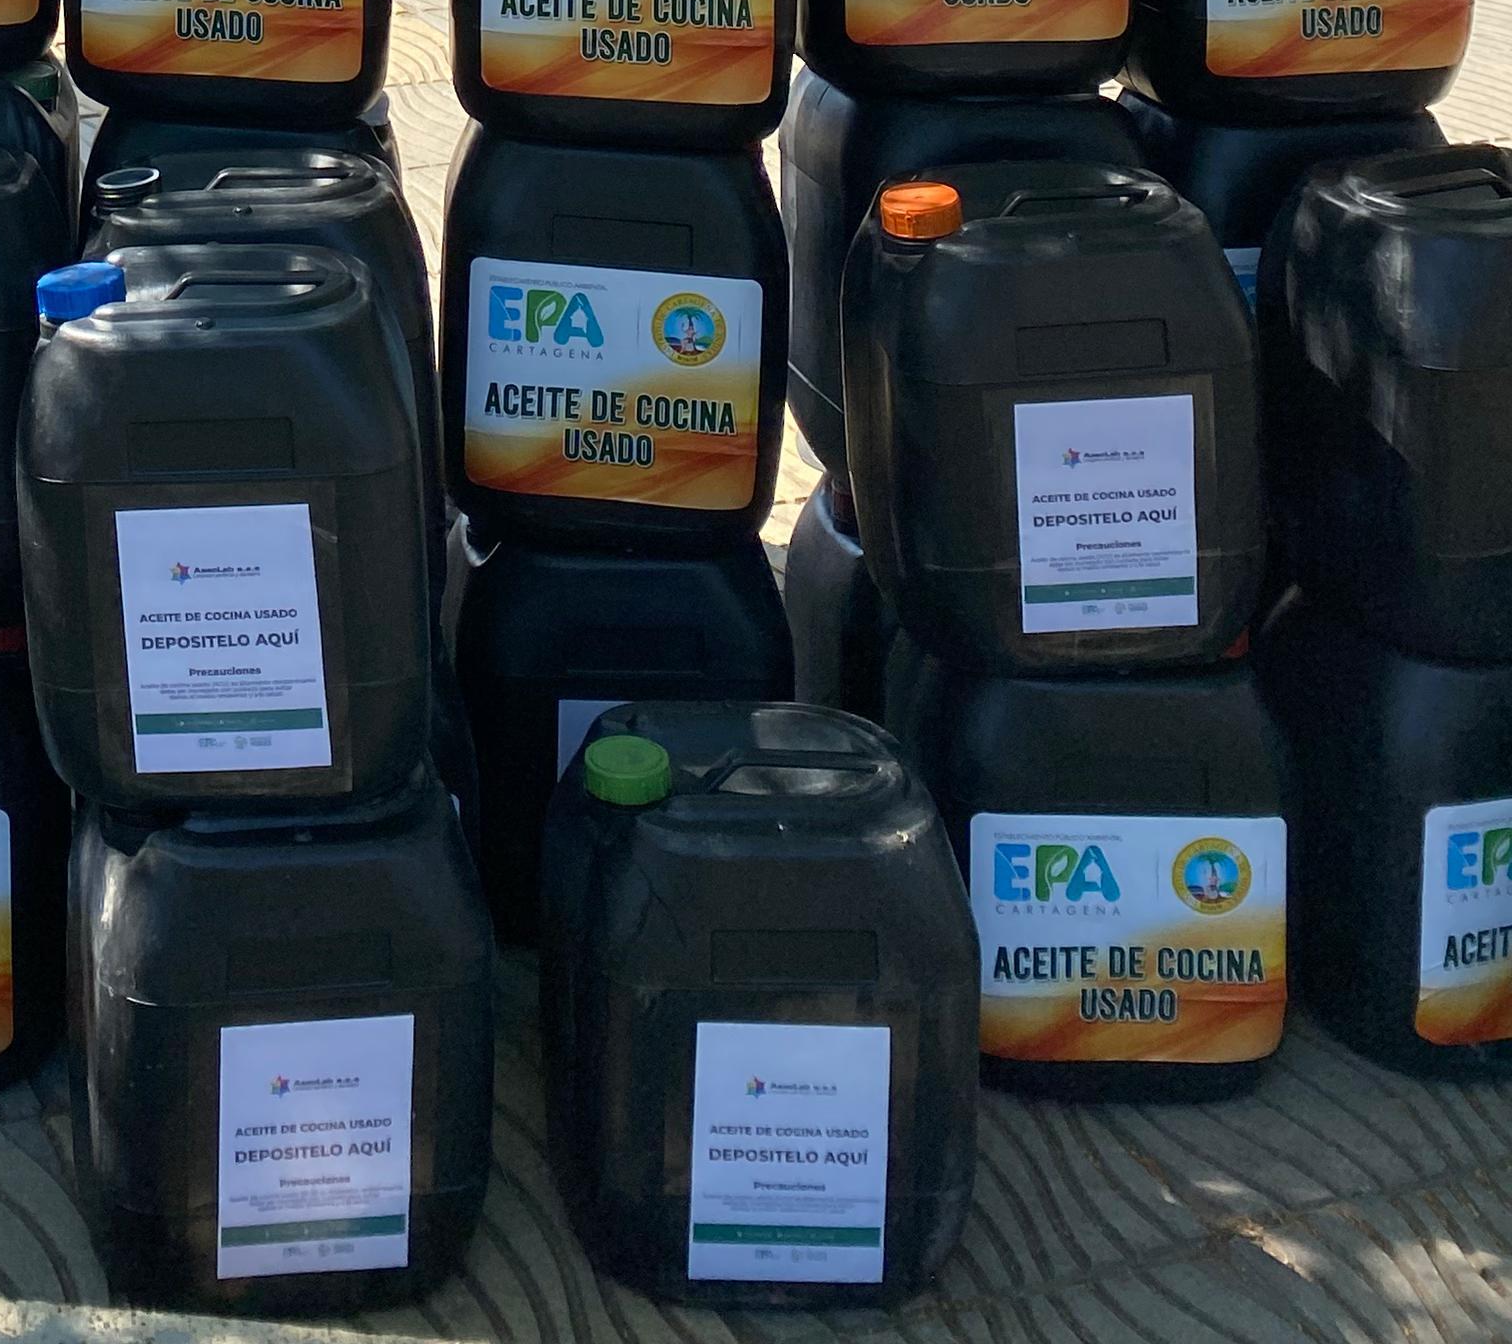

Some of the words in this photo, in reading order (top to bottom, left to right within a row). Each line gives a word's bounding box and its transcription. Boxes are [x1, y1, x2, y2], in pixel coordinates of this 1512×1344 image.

[176, 7, 264, 44] USADO
[1301, 6, 1383, 40] USADO
[581, 27, 672, 66] USADO
[489, 285, 604, 348] EPA
[489, 342, 604, 361] CARTAGENA
[484, 382, 581, 421] ACEITE
[591, 389, 625, 424] DE
[636, 393, 736, 435] COCINA
[564, 428, 655, 468] USADO
[1032, 494, 1071, 504] ACEITE
[1074, 493, 1089, 502] DE
[1092, 490, 1134, 501] COCINA
[1137, 488, 1176, 498] USADO
[1033, 512, 1133, 528] DEPOSITELO
[1137, 506, 1177, 523] AQUÍ
[1076, 540, 1141, 552] Precauciones
[139, 612, 181, 623] ACEITE
[185, 612, 202, 622] DE
[204, 610, 251, 622] COCINA
[254, 608, 297, 620] USADO
[141, 634, 250, 650] DEPOSITELO
[256, 629, 300, 648] AQUÍ
[189, 666, 262, 677] Precauciones
[1447, 827, 1512, 890] EP
[994, 843, 1121, 901] EPA
[995, 904, 1121, 917] CARTAGENA
[1443, 925, 1512, 969] ACEIT
[993, 946, 1098, 983] ACEITE
[1108, 946, 1146, 982] DE
[1157, 946, 1266, 985] COCINA
[1080, 988, 1178, 1023] USADO
[235, 1126, 277, 1138] ACEITE
[281, 1124, 297, 1134] DE
[300, 1121, 346, 1133] COCINA
[350, 1118, 392, 1130] USADO
[710, 1126, 752, 1136] ACEITE
[756, 1126, 772, 1137] DE
[776, 1127, 822, 1138] COCINA
[826, 1128, 870, 1139] USADO
[235, 1143, 342, 1164] DEPOSITELO
[348, 1138, 392, 1157] AQUÍ
[709, 1147, 818, 1164] DEPOSITELO
[824, 1148, 869, 1168] AQUÍ
